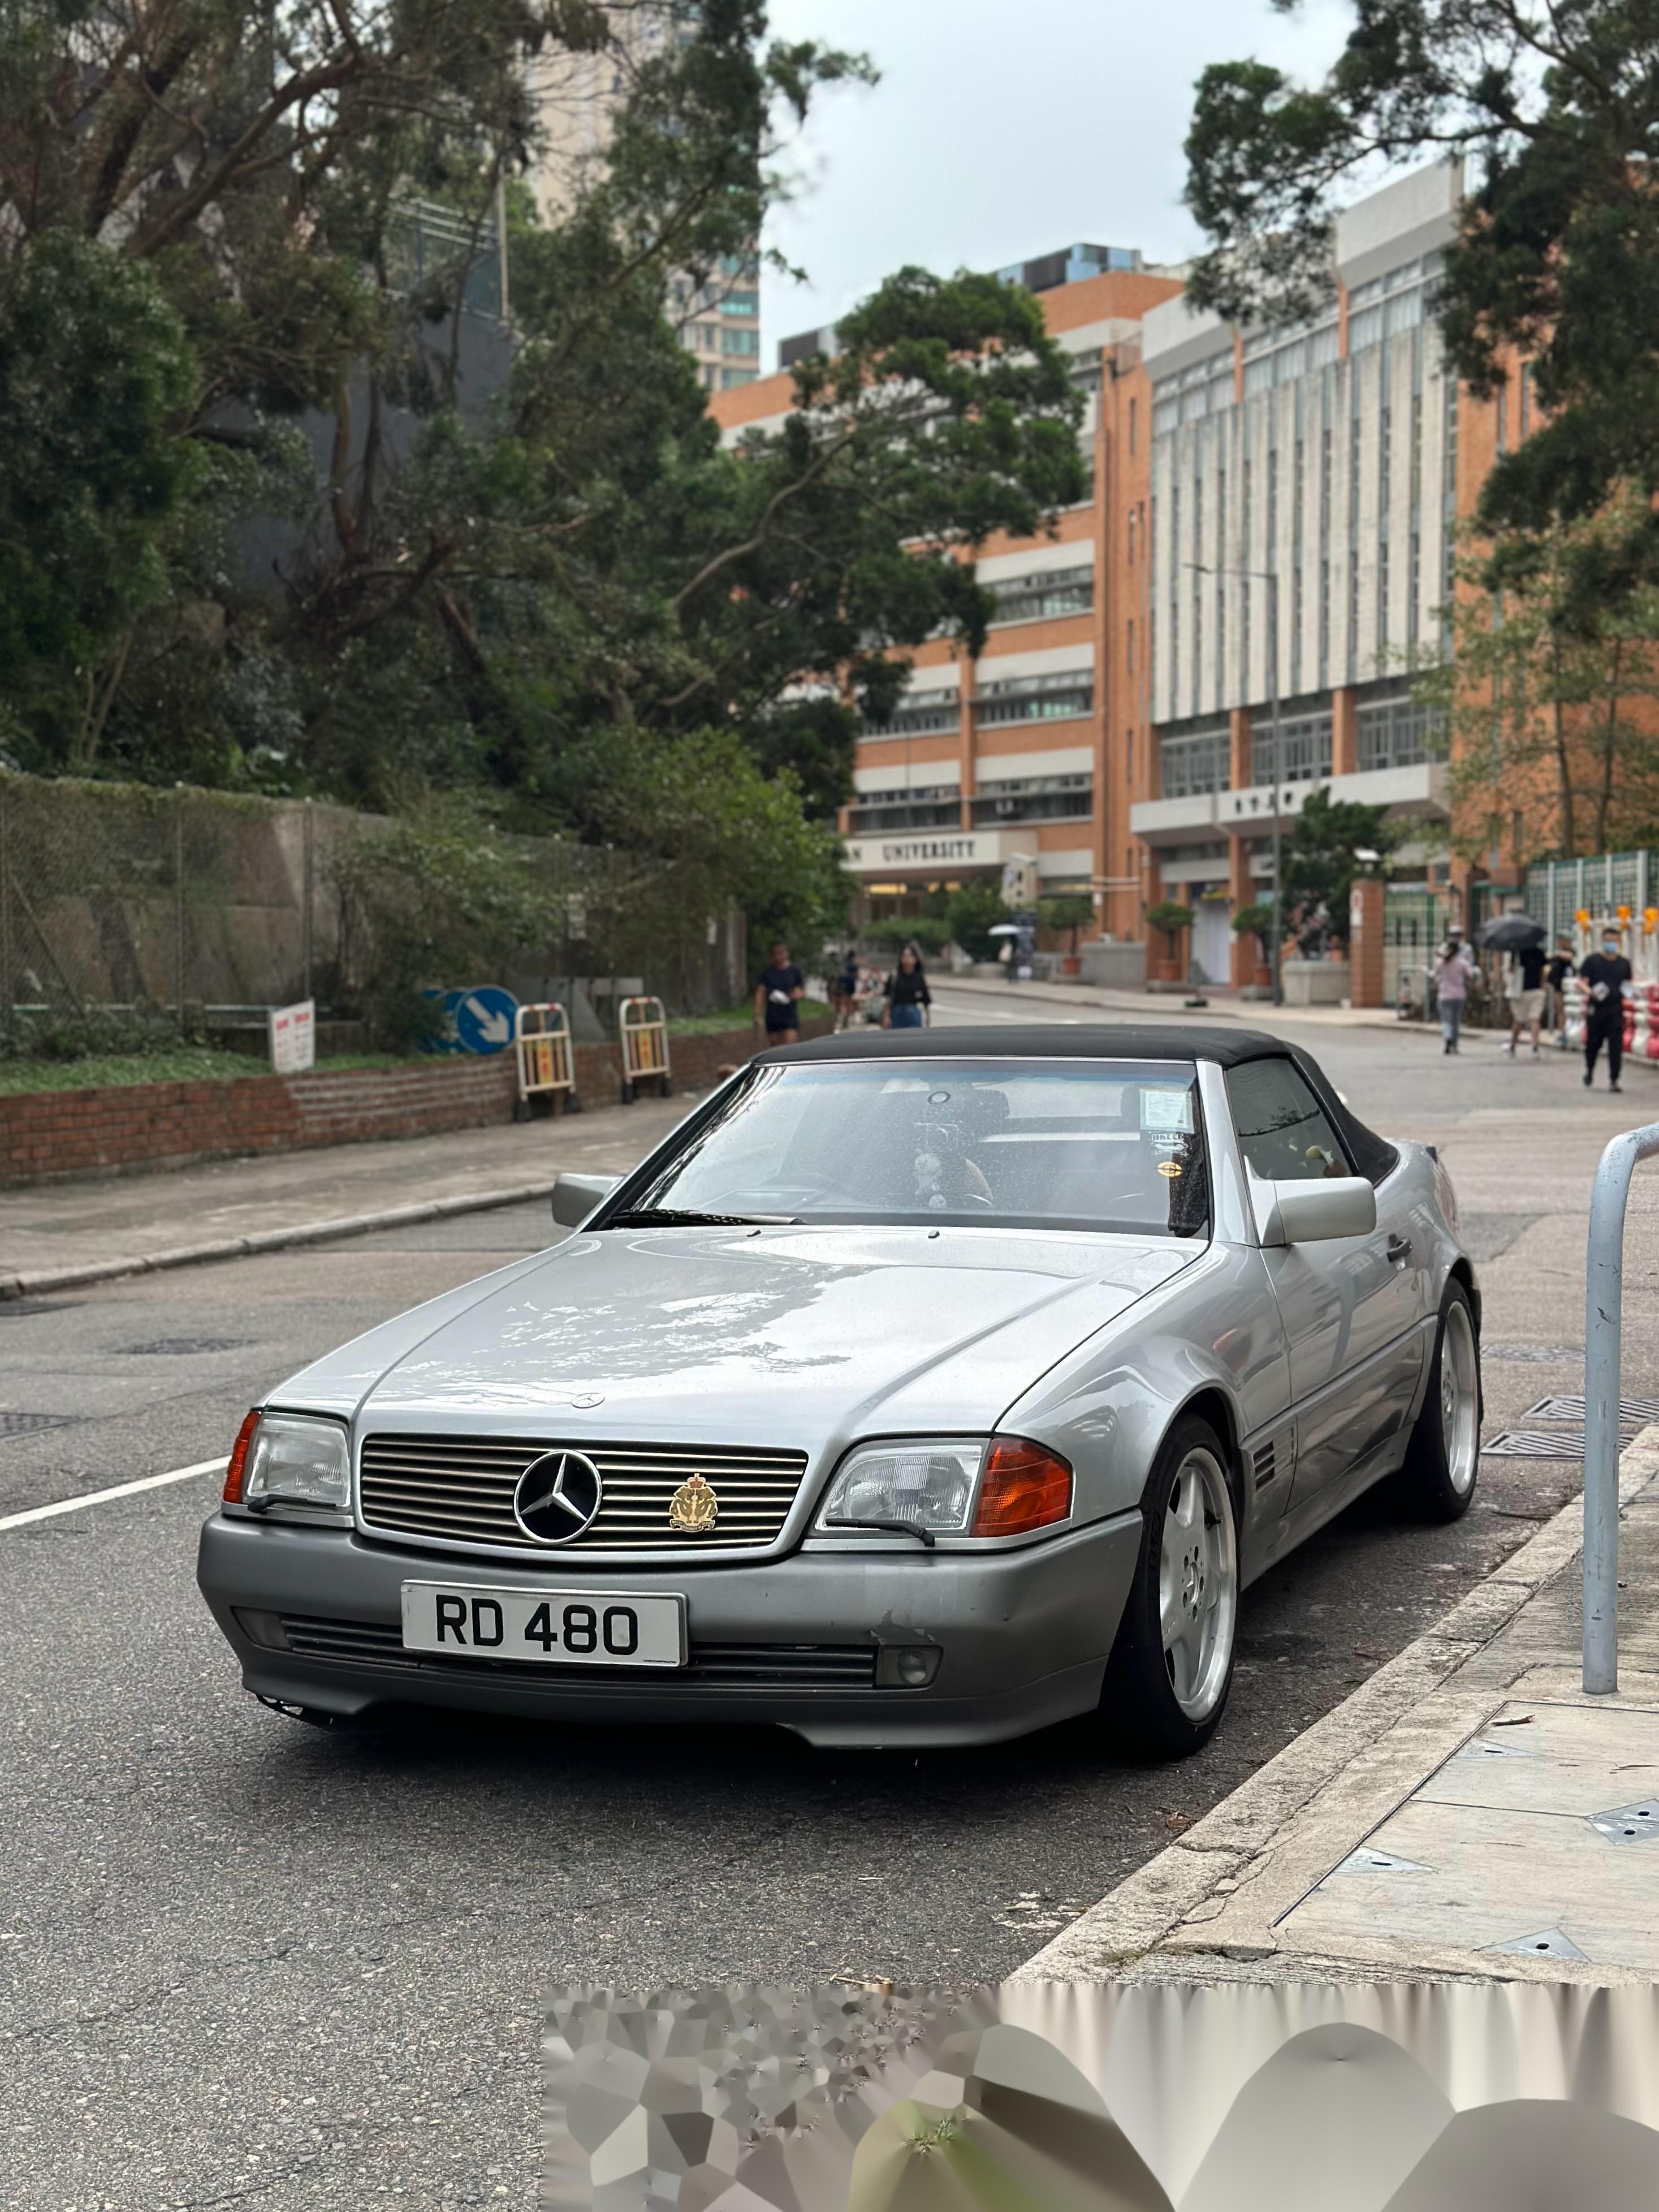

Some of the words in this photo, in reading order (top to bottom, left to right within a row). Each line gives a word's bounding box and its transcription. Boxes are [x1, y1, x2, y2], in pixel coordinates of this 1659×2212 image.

[883, 840, 975, 862] UNIVERSITY
[436, 1595, 503, 1647] RD
[525, 1603, 638, 1655] 480
